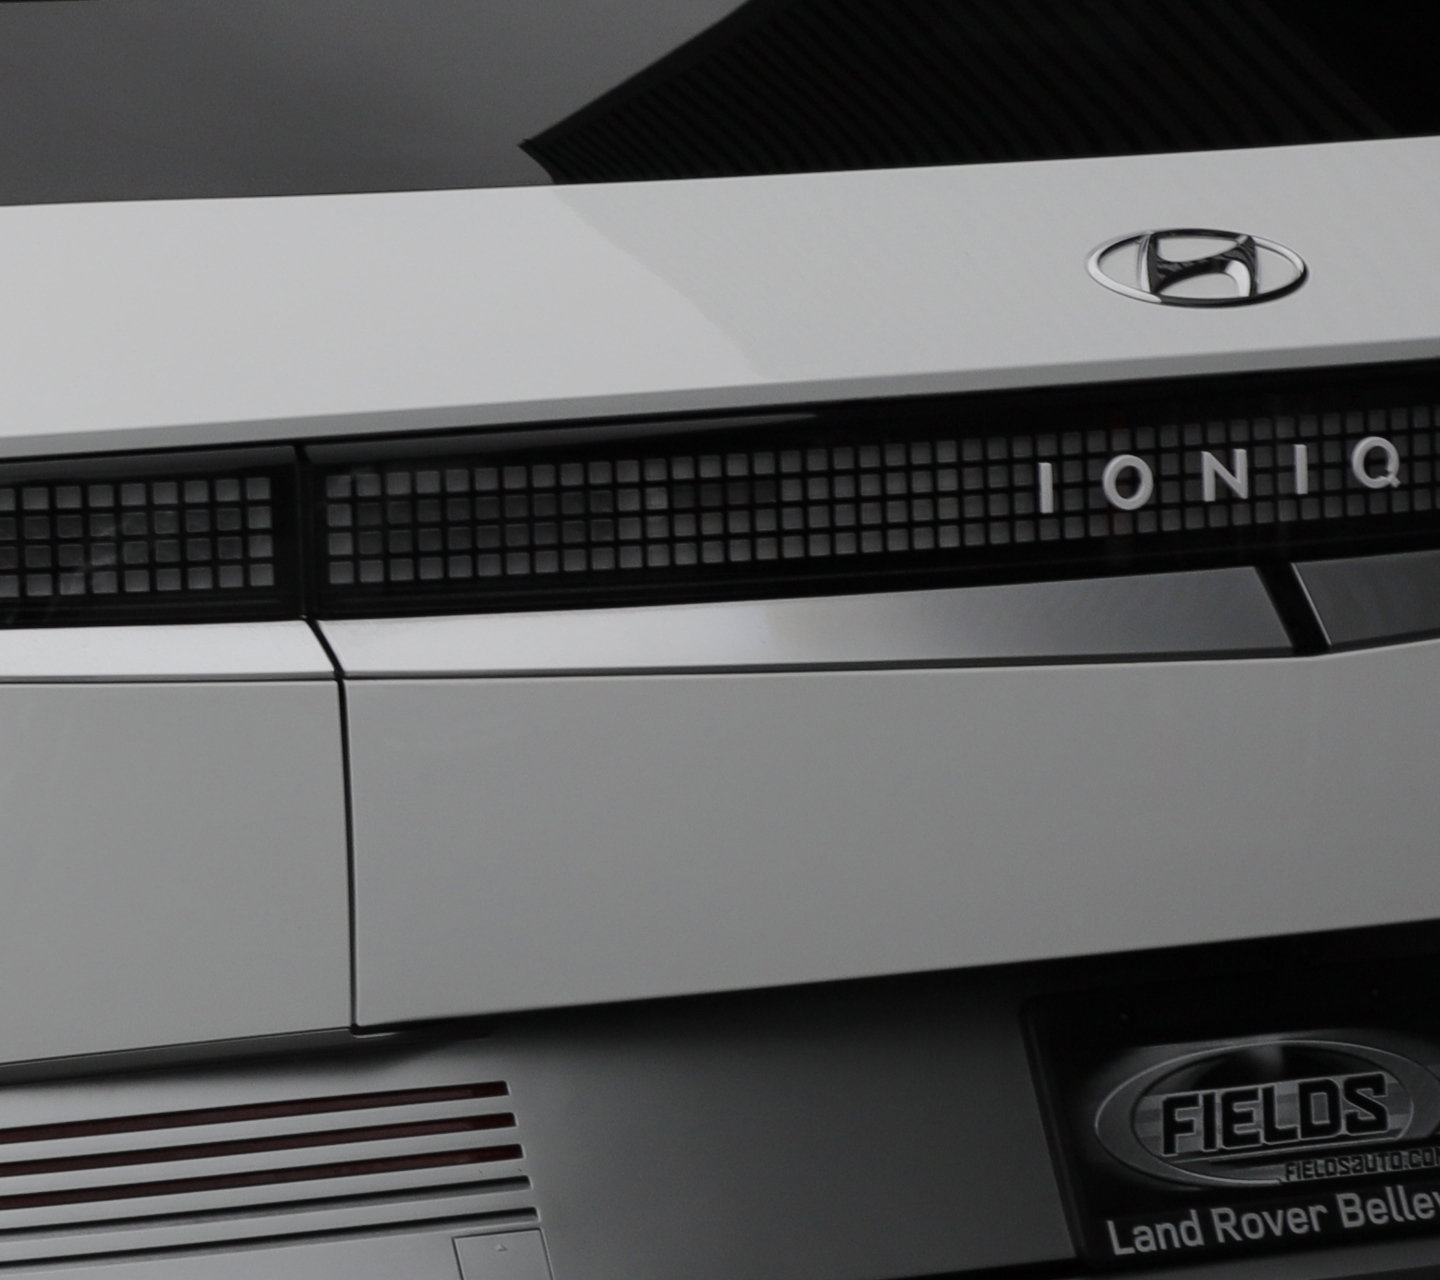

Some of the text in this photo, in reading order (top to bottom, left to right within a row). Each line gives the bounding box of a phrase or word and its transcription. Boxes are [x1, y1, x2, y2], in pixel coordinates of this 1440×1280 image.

[1161, 1072, 1389, 1156] FIELDS
[1107, 1208, 1204, 1256] Land
[1212, 1204, 1328, 1244] Rover
